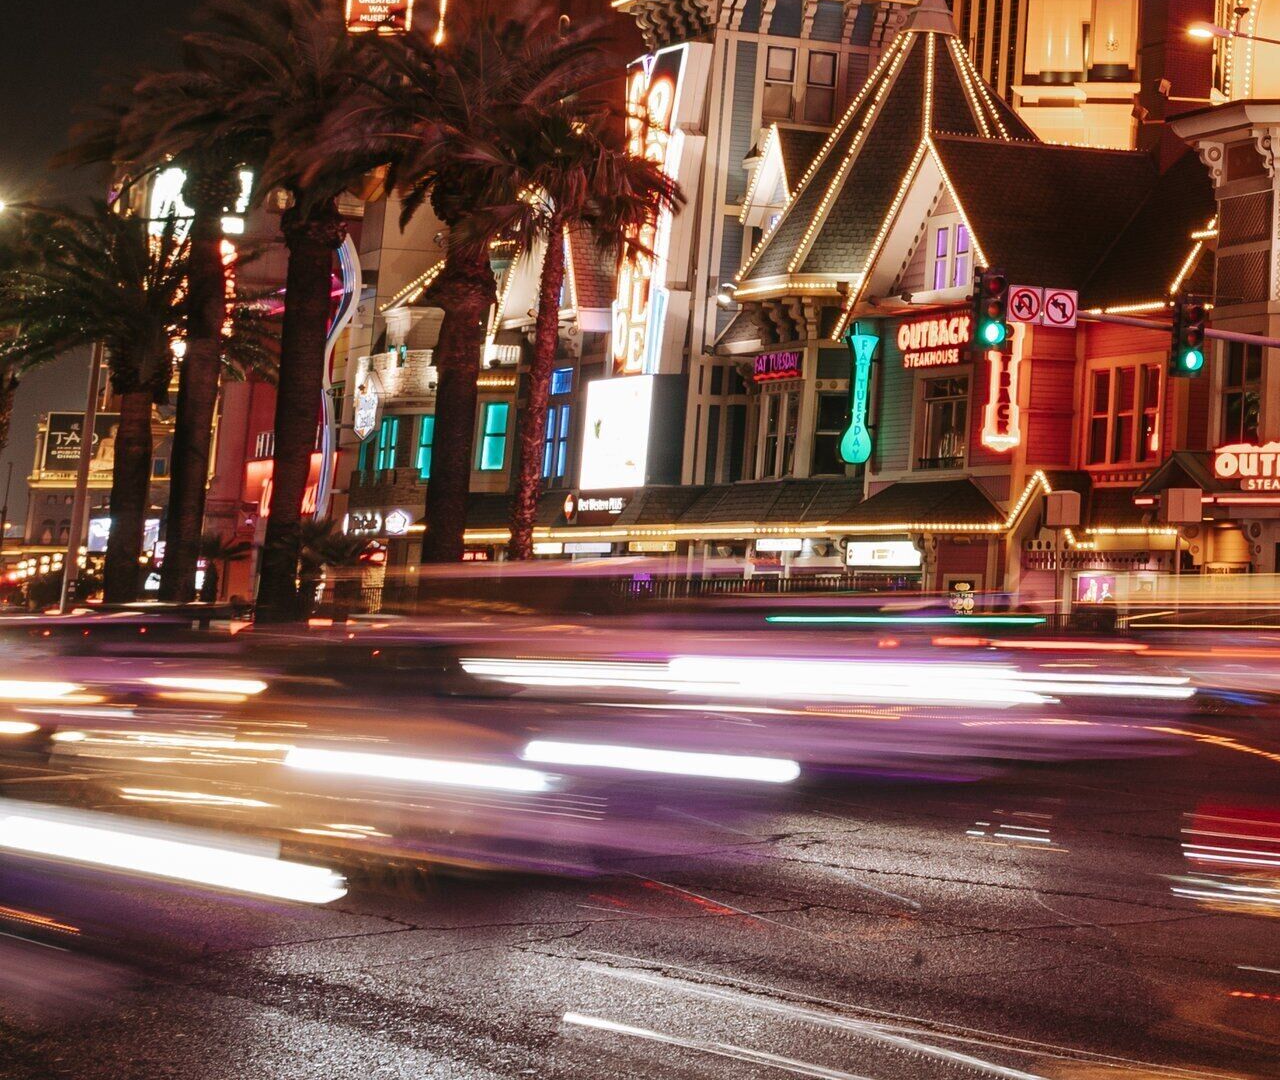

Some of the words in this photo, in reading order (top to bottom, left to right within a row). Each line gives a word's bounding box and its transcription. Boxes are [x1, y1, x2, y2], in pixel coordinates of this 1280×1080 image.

[368, 5, 389, 13] WAX
[898, 315, 970, 351] OUTBACK
[769, 352, 800, 371] TUESDAY
[857, 339, 869, 372] FAT
[903, 348, 960, 368] STEAKHOUSE
[851, 377, 867, 459] TUESDAY
